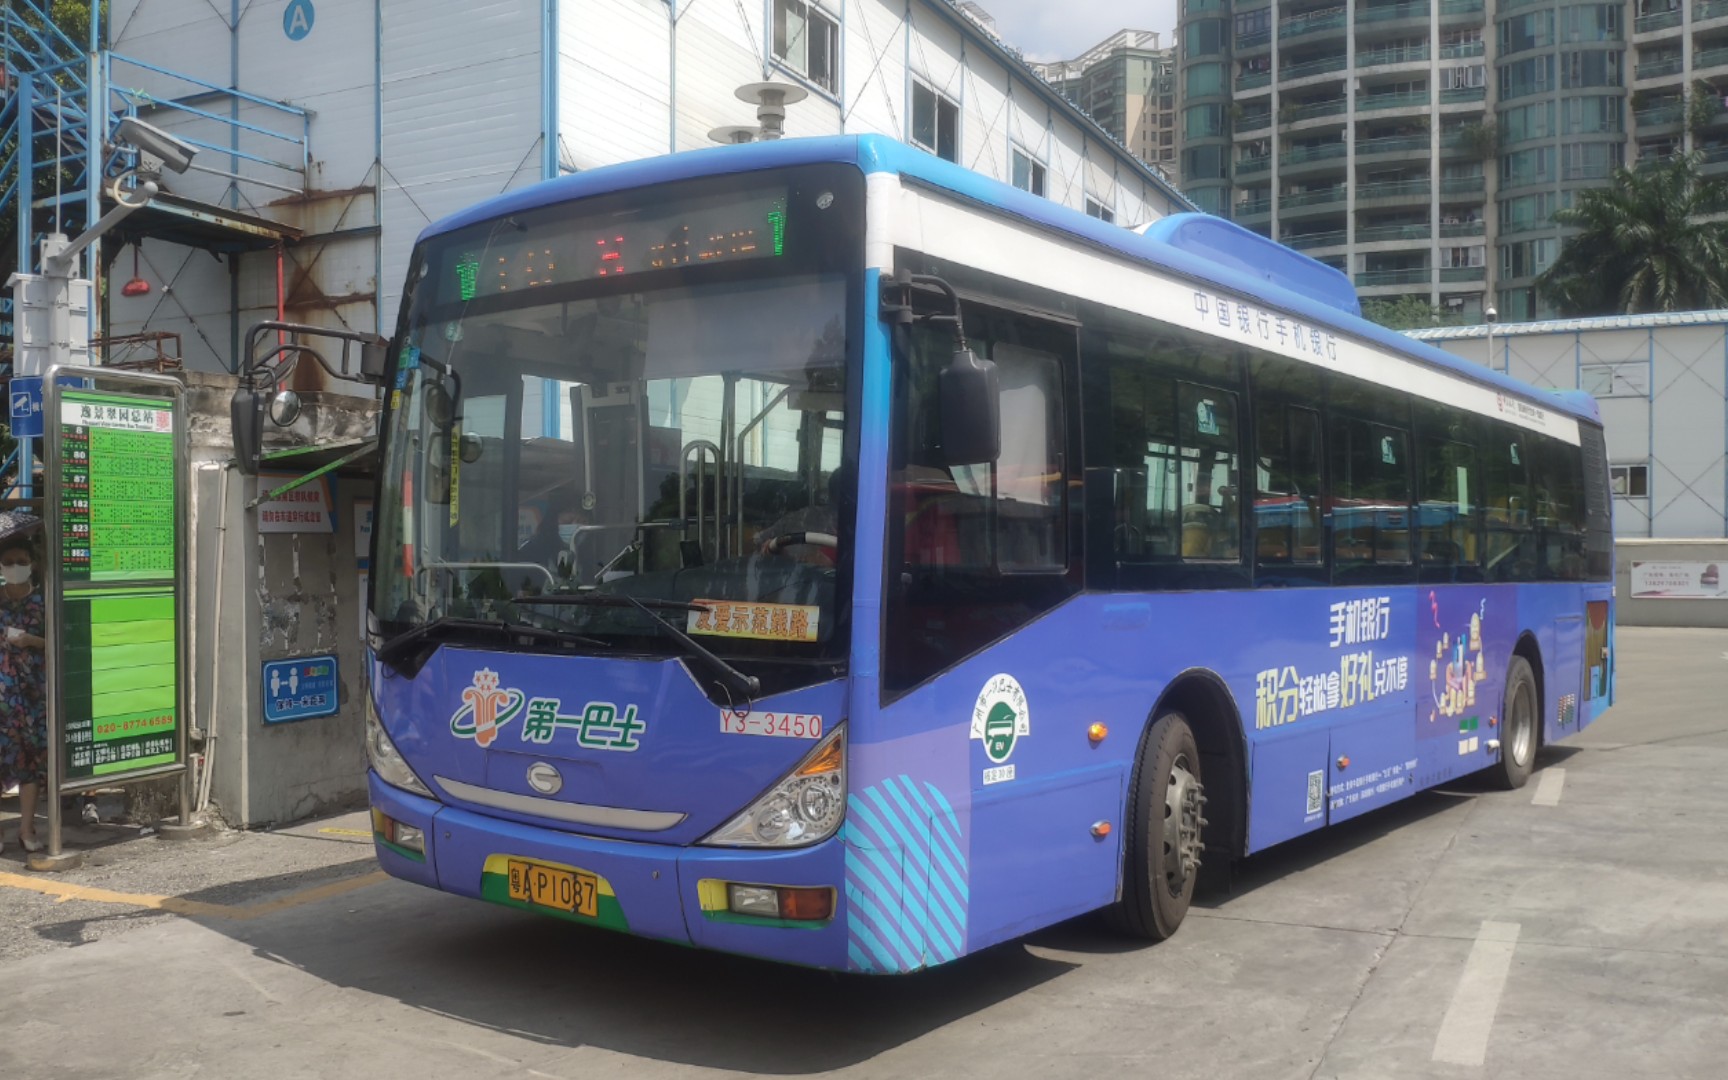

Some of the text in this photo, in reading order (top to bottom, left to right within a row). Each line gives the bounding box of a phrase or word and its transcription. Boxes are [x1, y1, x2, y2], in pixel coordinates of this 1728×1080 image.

[290, 4, 309, 35] A
[1194, 288, 1337, 361] 中国银行手机银行
[72, 499, 89, 508] 182
[72, 524, 89, 532] 823
[1329, 597, 1390, 648] 手机银行
[1256, 650, 1409, 731] 积分轻松拿好礼兑不停
[521, 696, 646, 752] 第一巴士
[721, 710, 821, 738] Y3-3450
